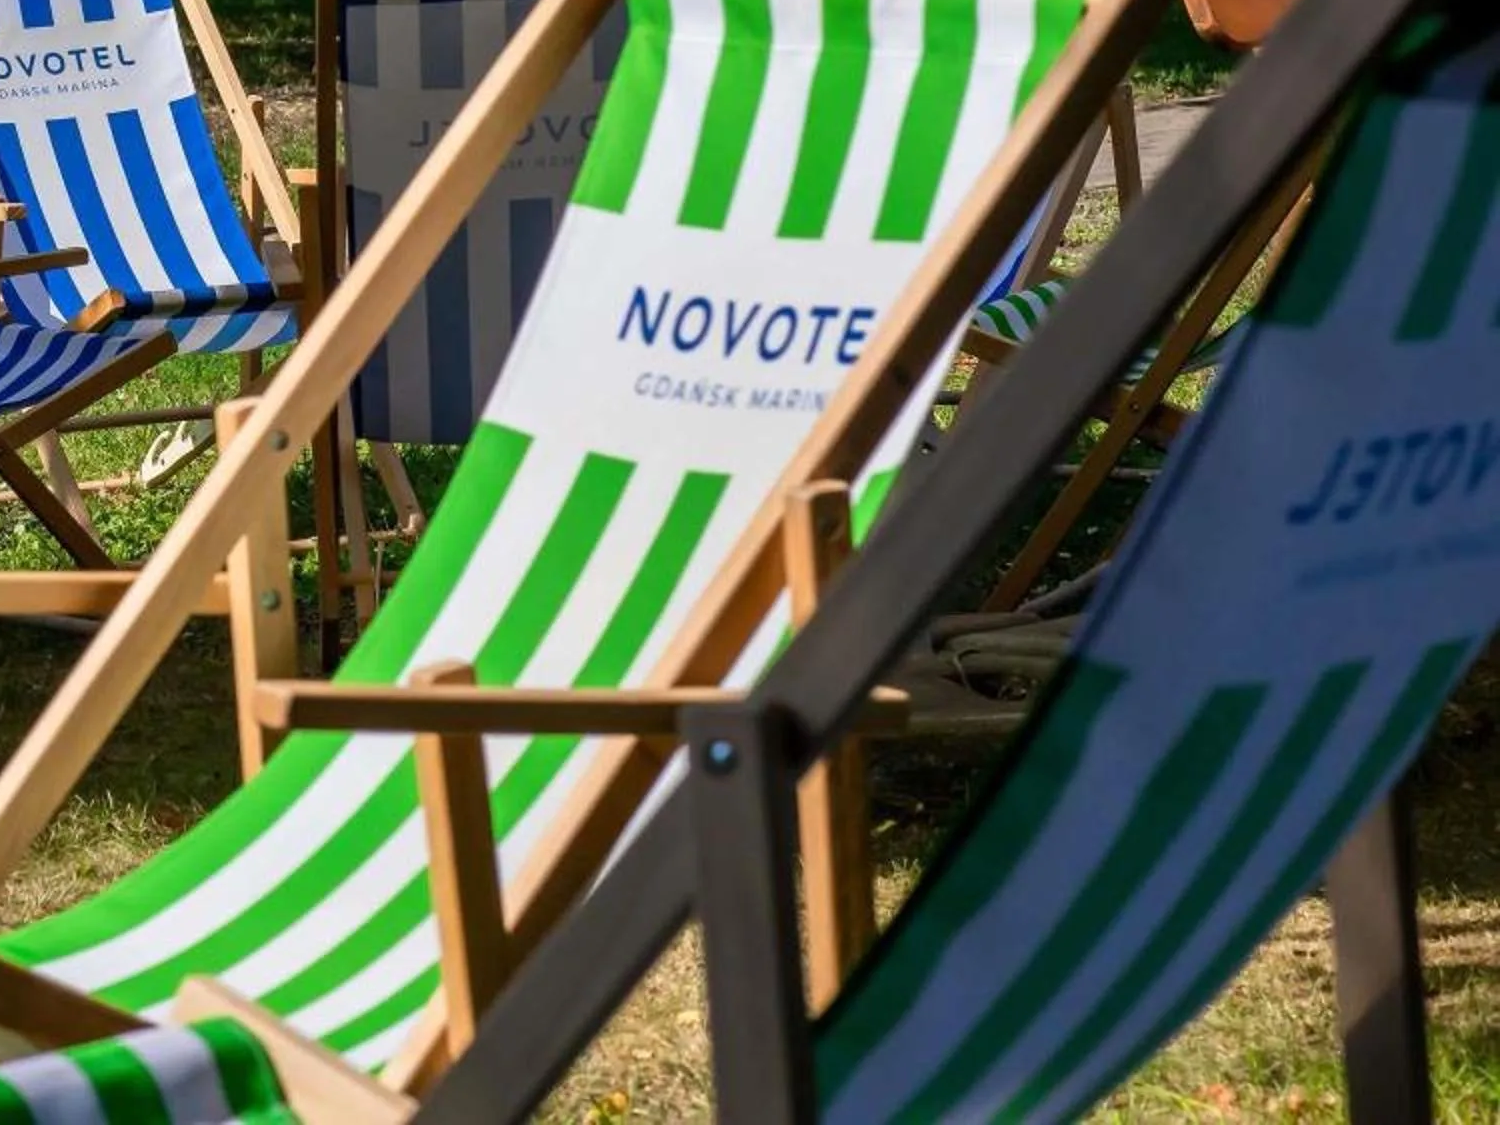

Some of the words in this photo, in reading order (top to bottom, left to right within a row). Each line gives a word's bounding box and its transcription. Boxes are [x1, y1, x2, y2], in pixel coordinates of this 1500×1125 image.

[57, 77, 119, 94] MARINA
[617, 285, 877, 365] NOVOTE
[747, 387, 828, 413] MARIN
